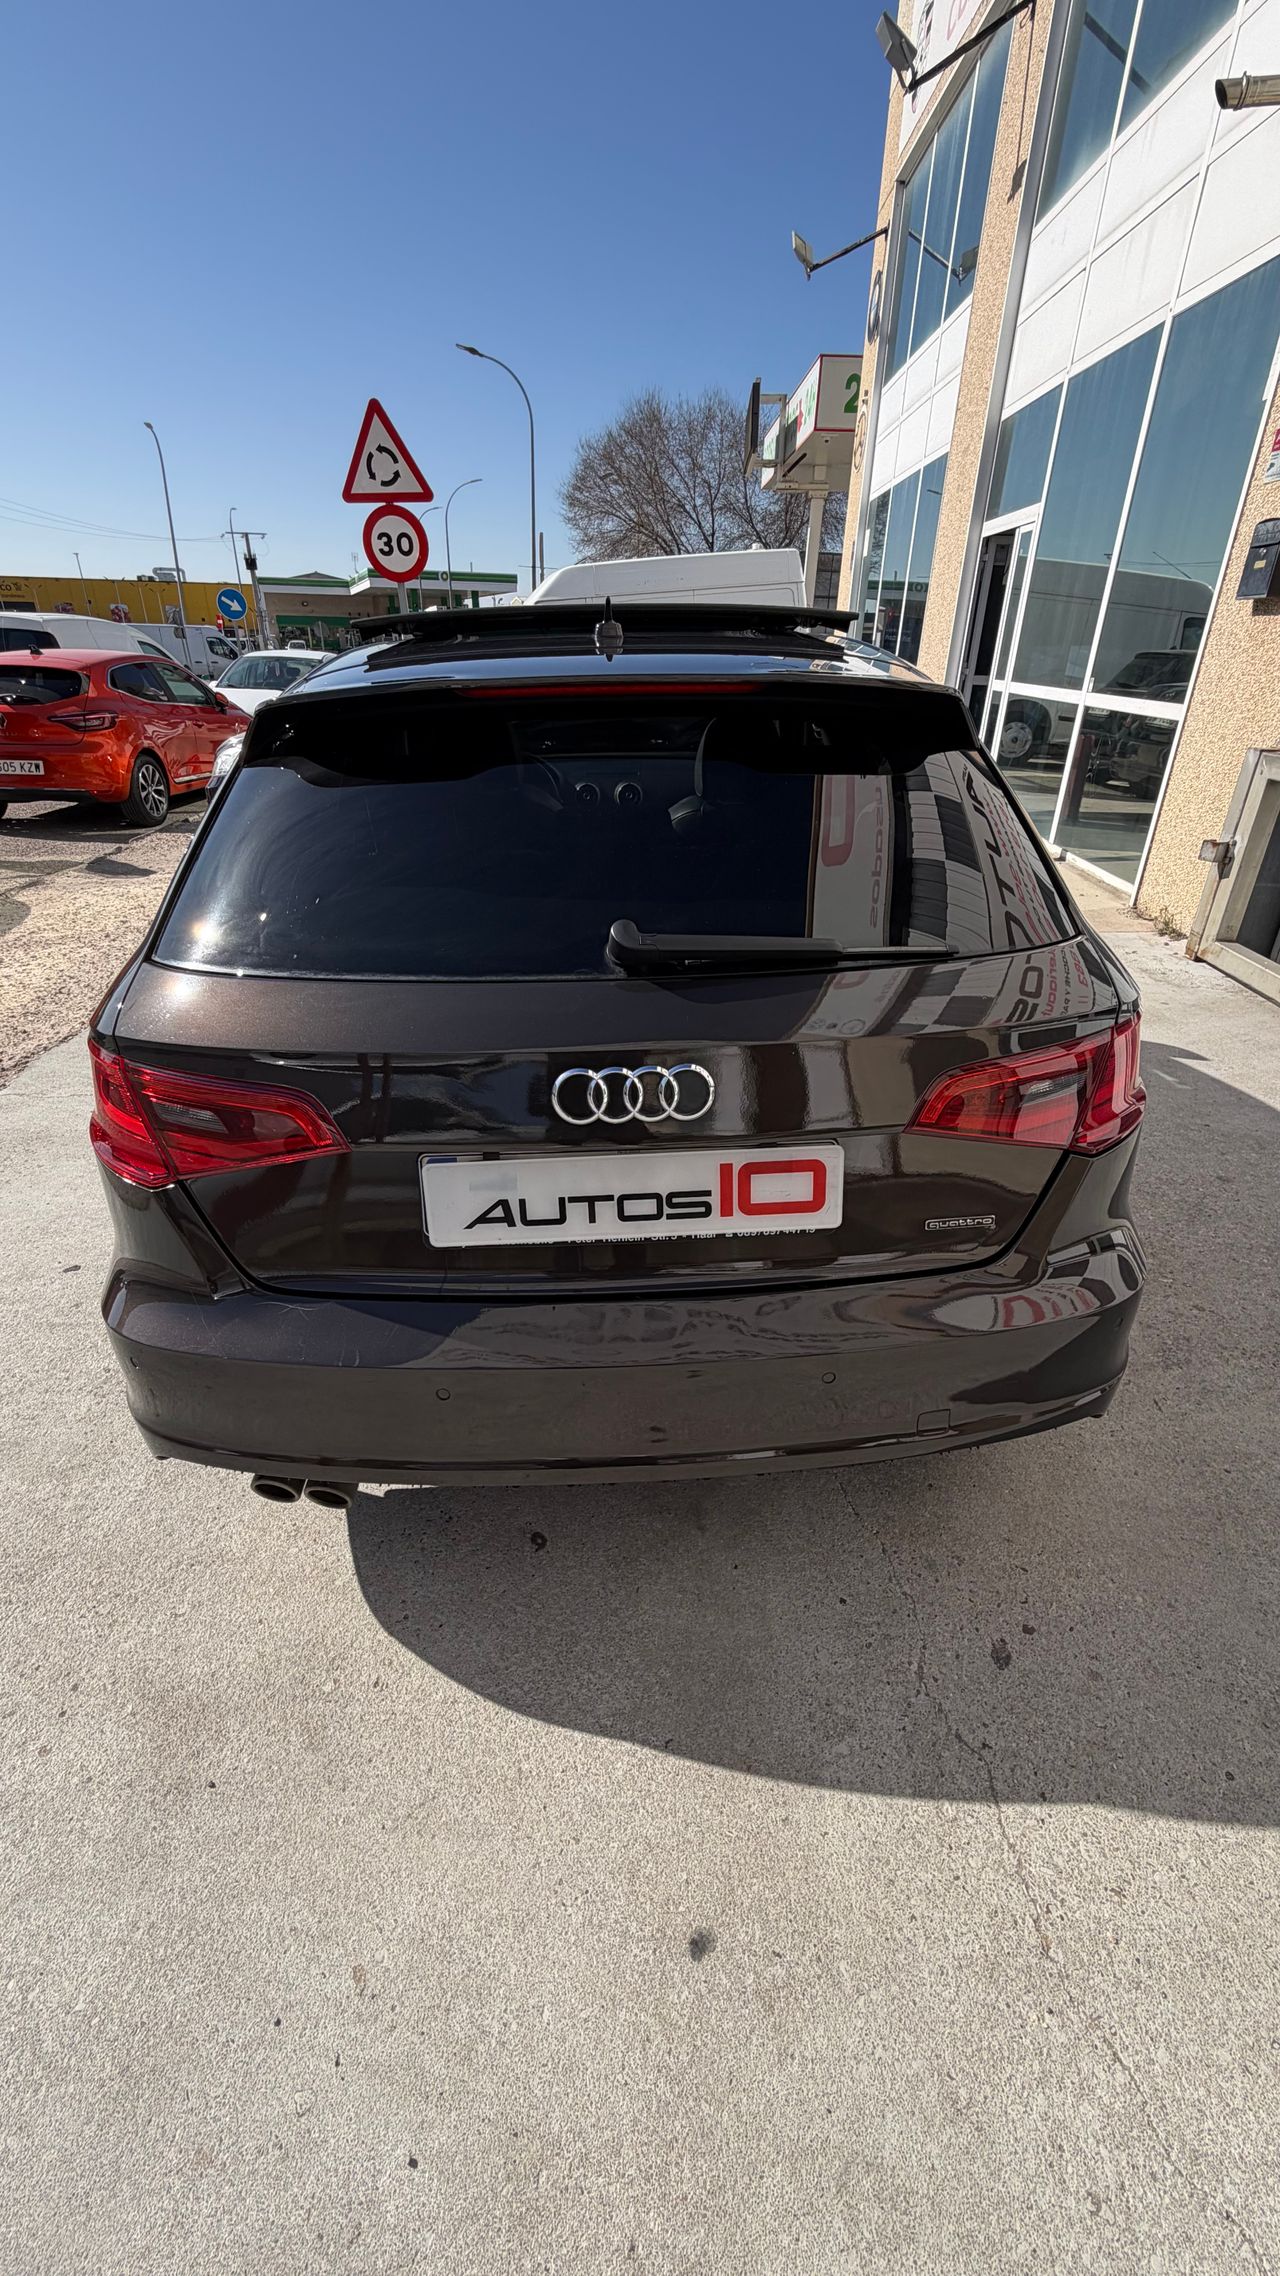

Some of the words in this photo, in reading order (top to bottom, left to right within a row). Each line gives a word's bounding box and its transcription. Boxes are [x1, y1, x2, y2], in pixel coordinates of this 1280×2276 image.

[377, 532, 414, 557] 30
[19, 762, 41, 773] KZW
[929, 1218, 992, 1230] quattro
